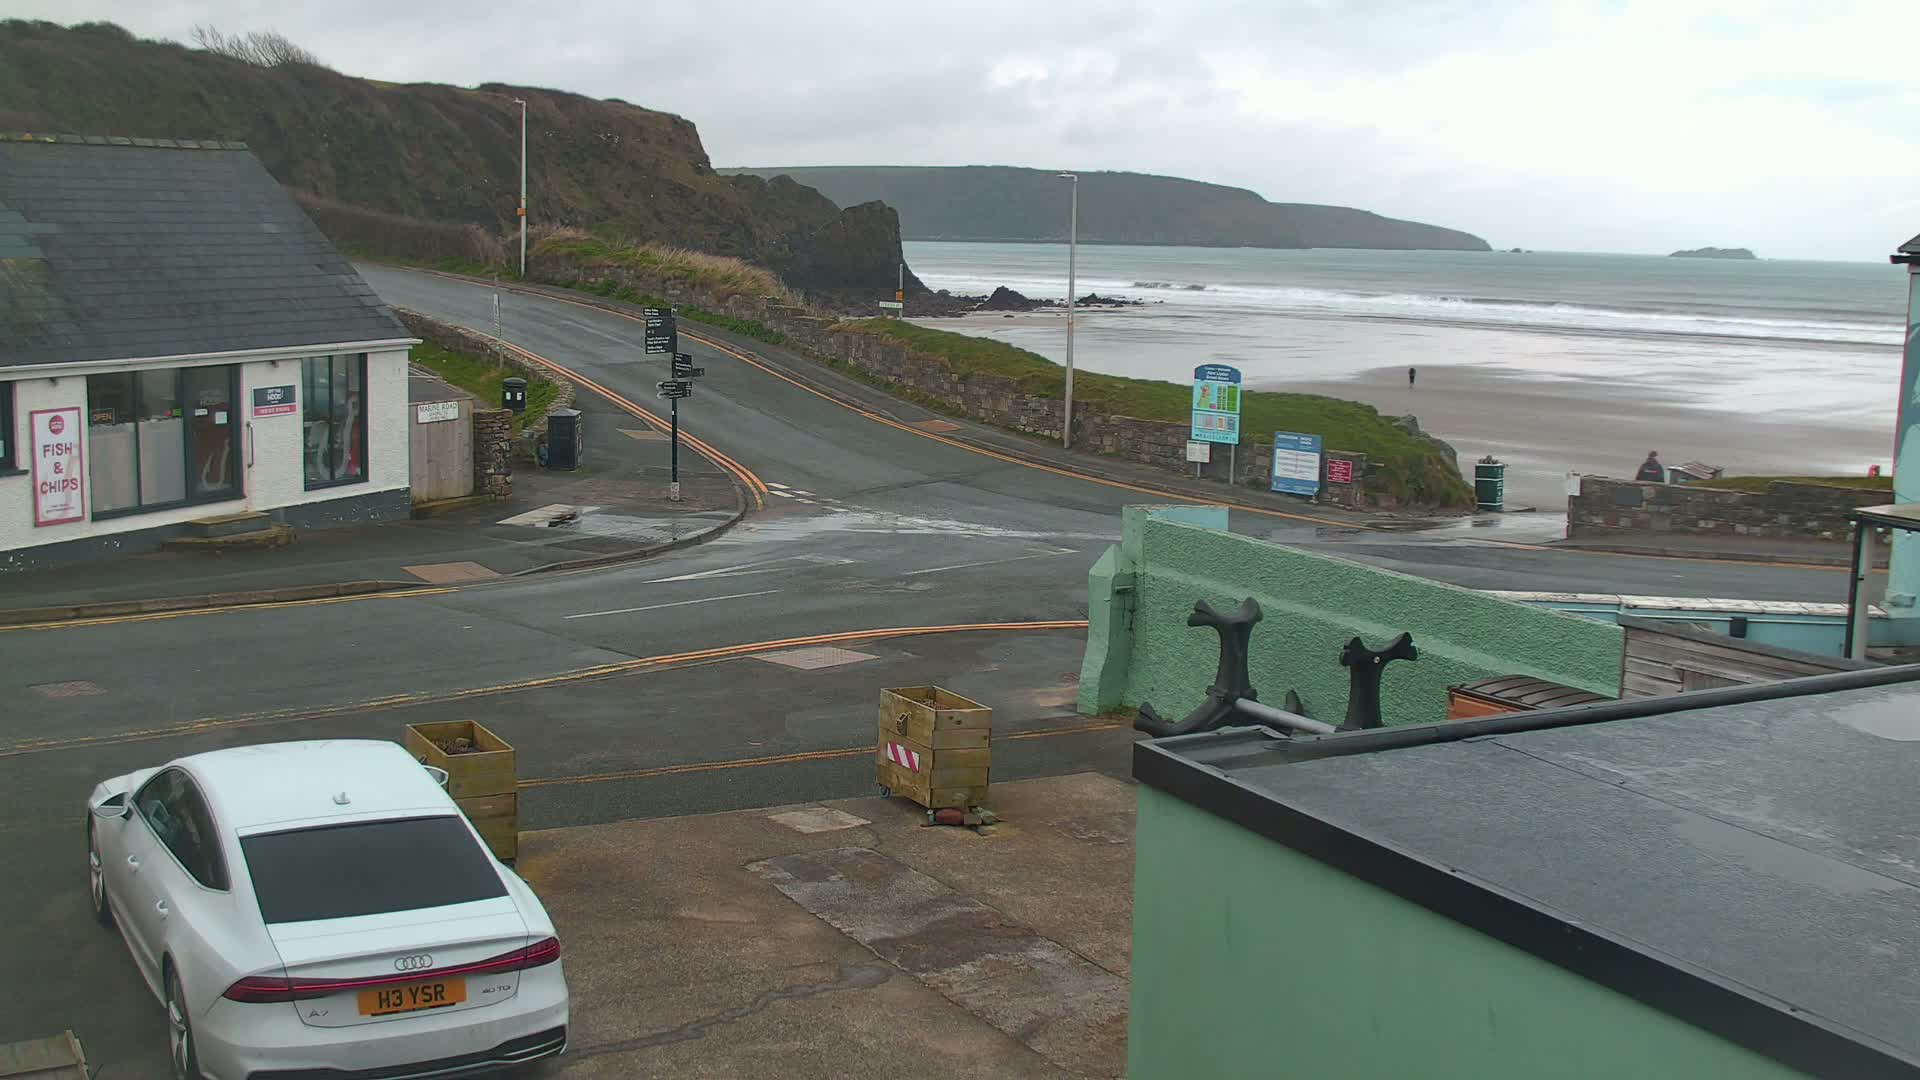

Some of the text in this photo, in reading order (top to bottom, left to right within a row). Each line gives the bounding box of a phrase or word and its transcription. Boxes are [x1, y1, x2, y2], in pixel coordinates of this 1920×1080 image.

[419, 401, 459, 412] MARINE ROAD
[93, 412, 113, 421] OPEN
[43, 442, 73, 458] FISH
[54, 461, 64, 474] &
[40, 478, 79, 496] CHIPS
[378, 983, 445, 1009] H3 YSR
[309, 1008, 329, 1018] A7
